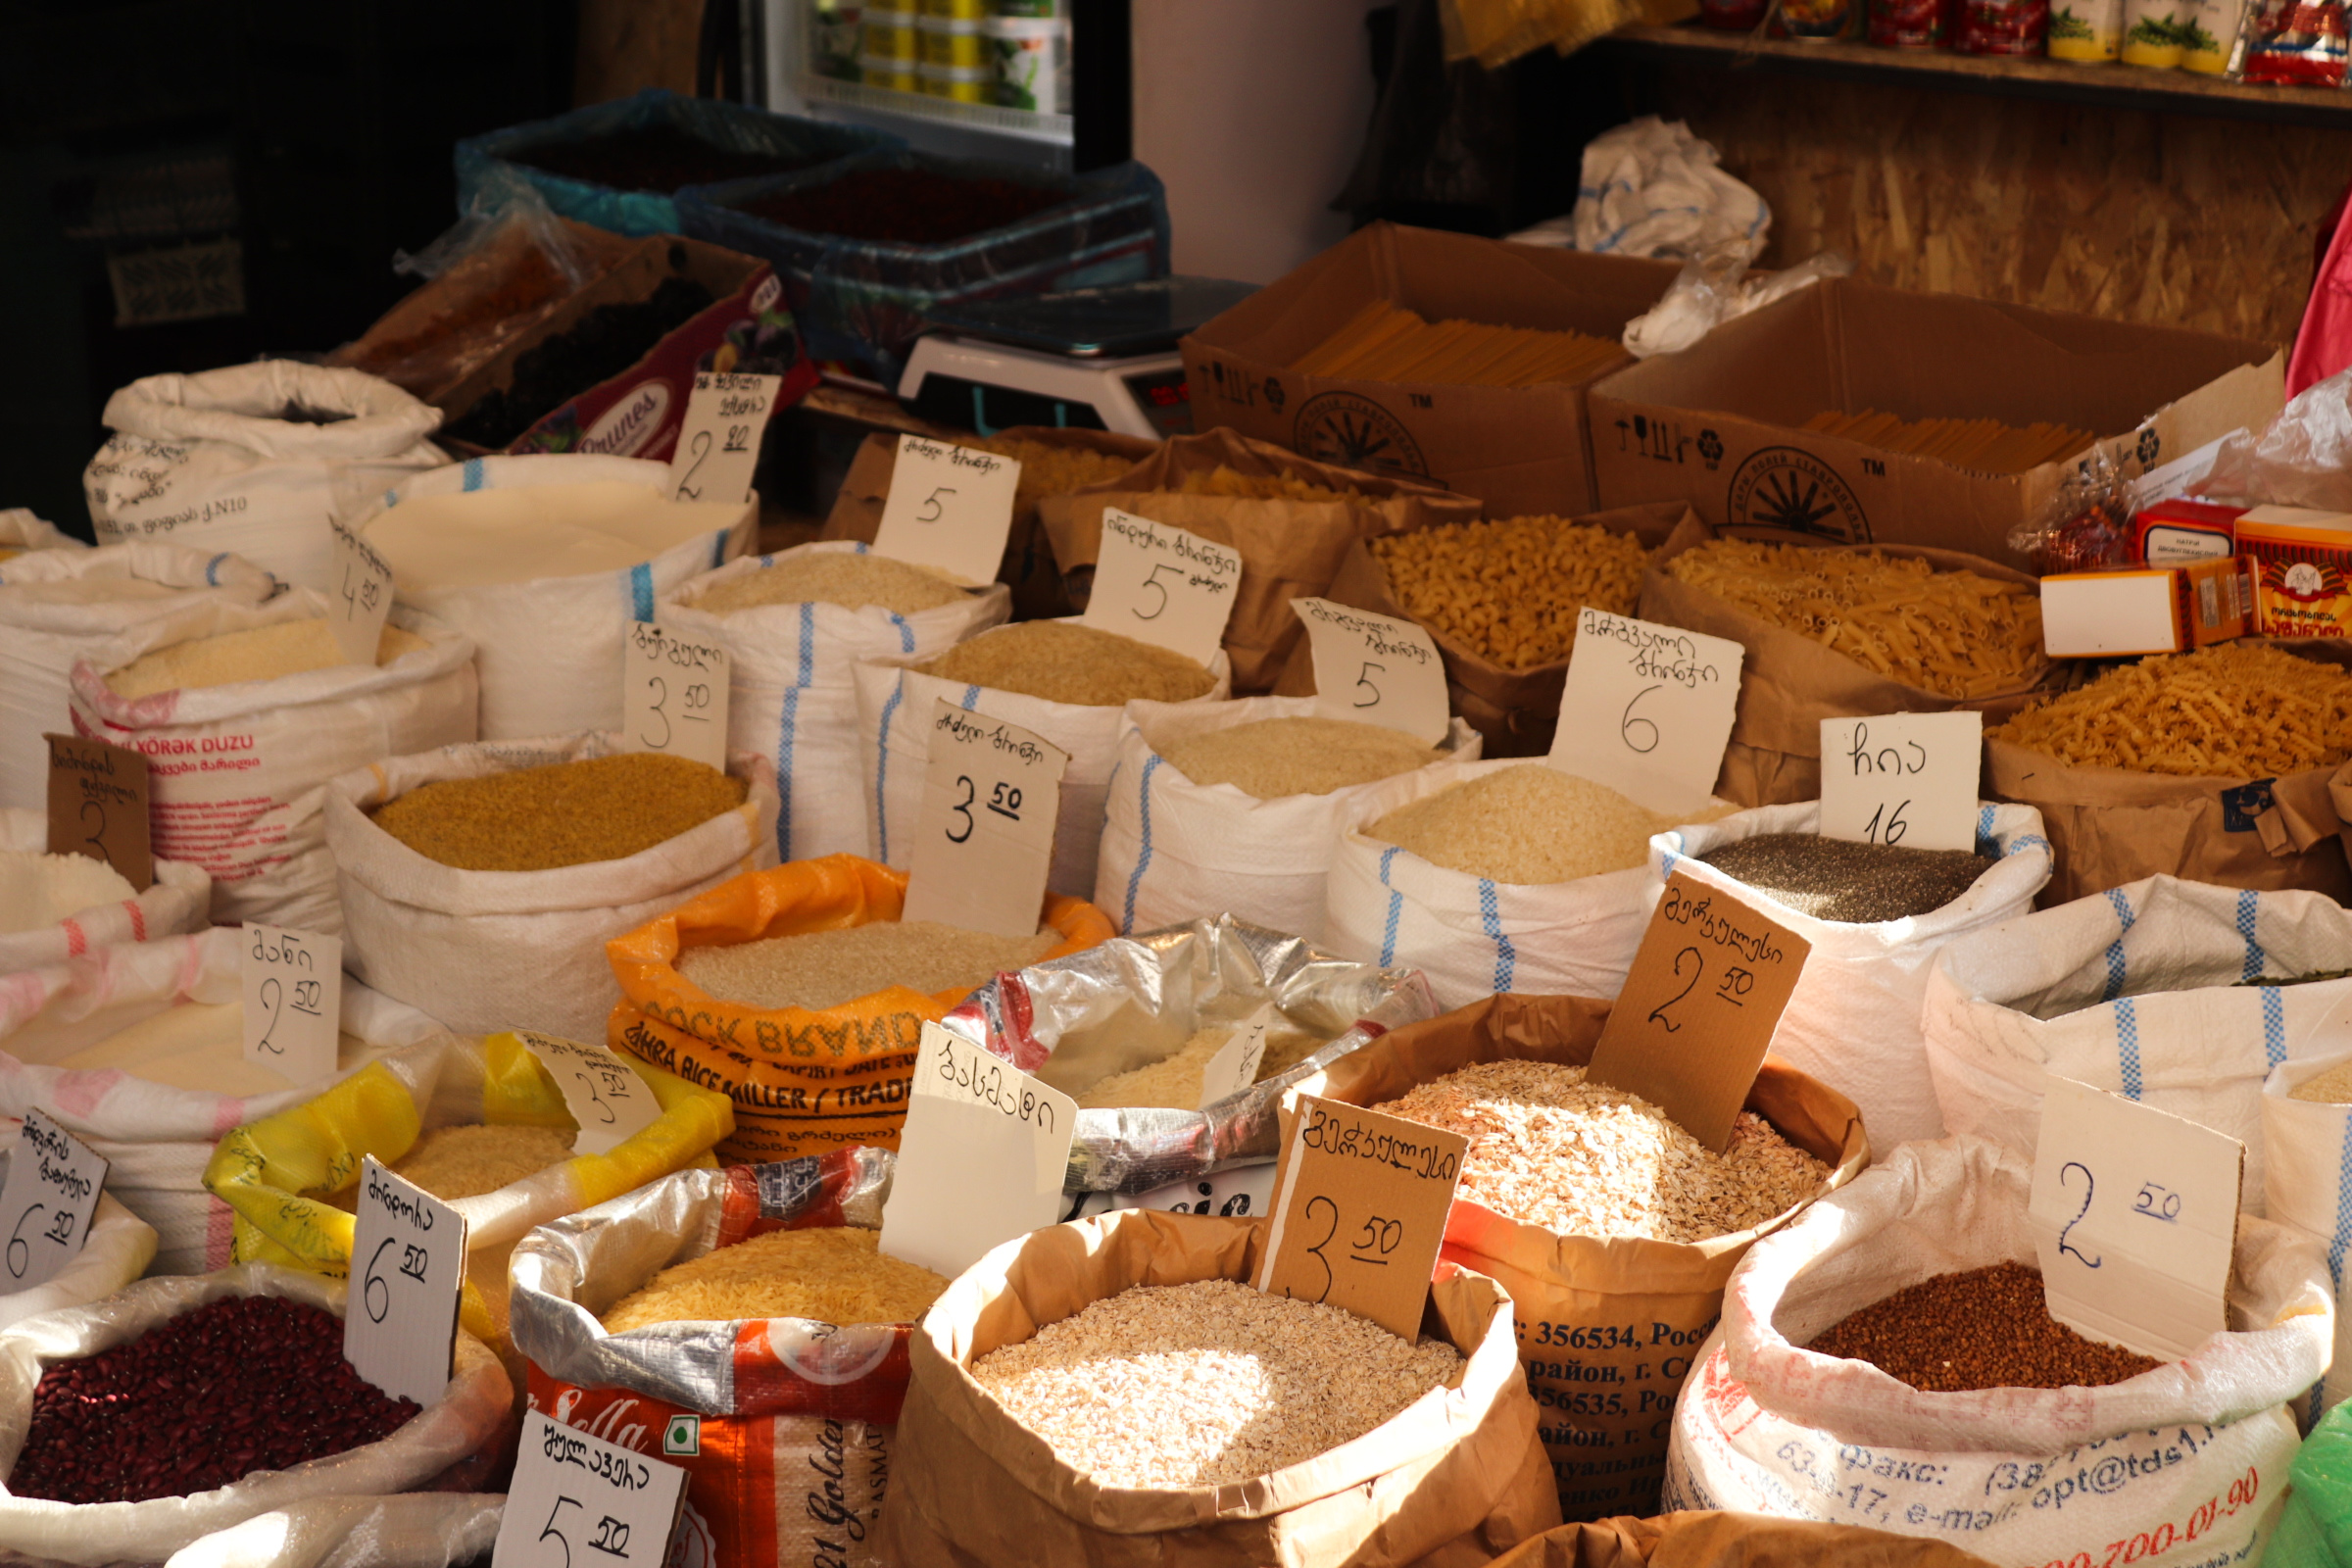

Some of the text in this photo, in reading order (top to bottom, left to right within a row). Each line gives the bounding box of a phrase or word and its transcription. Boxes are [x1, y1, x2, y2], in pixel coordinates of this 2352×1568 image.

[675, 429, 713, 502] 2
[1750, 452, 1788, 474] ПОЛЕЙ
[1861, 458, 1886, 477] TM
[915, 486, 957, 522] 5
[341, 562, 356, 622] 4
[1131, 563, 1185, 620] 5
[639, 675, 710, 750] 3 50
[1352, 661, 1387, 708] 5
[201, 734, 254, 755] DUZU
[1621, 683, 1664, 754] 6
[199, 756, 261, 773] მარილი
[1846, 721, 1927, 776] ჩია
[945, 773, 1023, 844] 3 50
[1863, 799, 1912, 846] 16
[252, 928, 313, 972] მანი
[257, 977, 321, 1055] 2 50
[1647, 945, 1754, 1034] 2 50
[574, 1071, 626, 1124] 3 50
[681, 1054, 722, 1090] RICE
[722, 1079, 808, 1110] MILLER
[938, 1039, 1054, 1135] ბასმატი
[6, 1202, 75, 1280] 6 50
[2058, 1161, 2182, 1269] 2 50
[1285, 1195, 1339, 1304] 3
[1351, 1215, 1402, 1255] 50
[364, 1236, 429, 1324] 6 50
[1534, 1320, 1642, 1351] 356534,
[1649, 1313, 1722, 1348] Росси
[1634, 1363, 1651, 1381] г.
[1539, 1421, 1615, 1448] айон,
[1622, 1428, 1641, 1446] г.
[1560, 1484, 1620, 1507] енко
[538, 1494, 584, 1568] 5
[594, 1514, 631, 1554] 50
